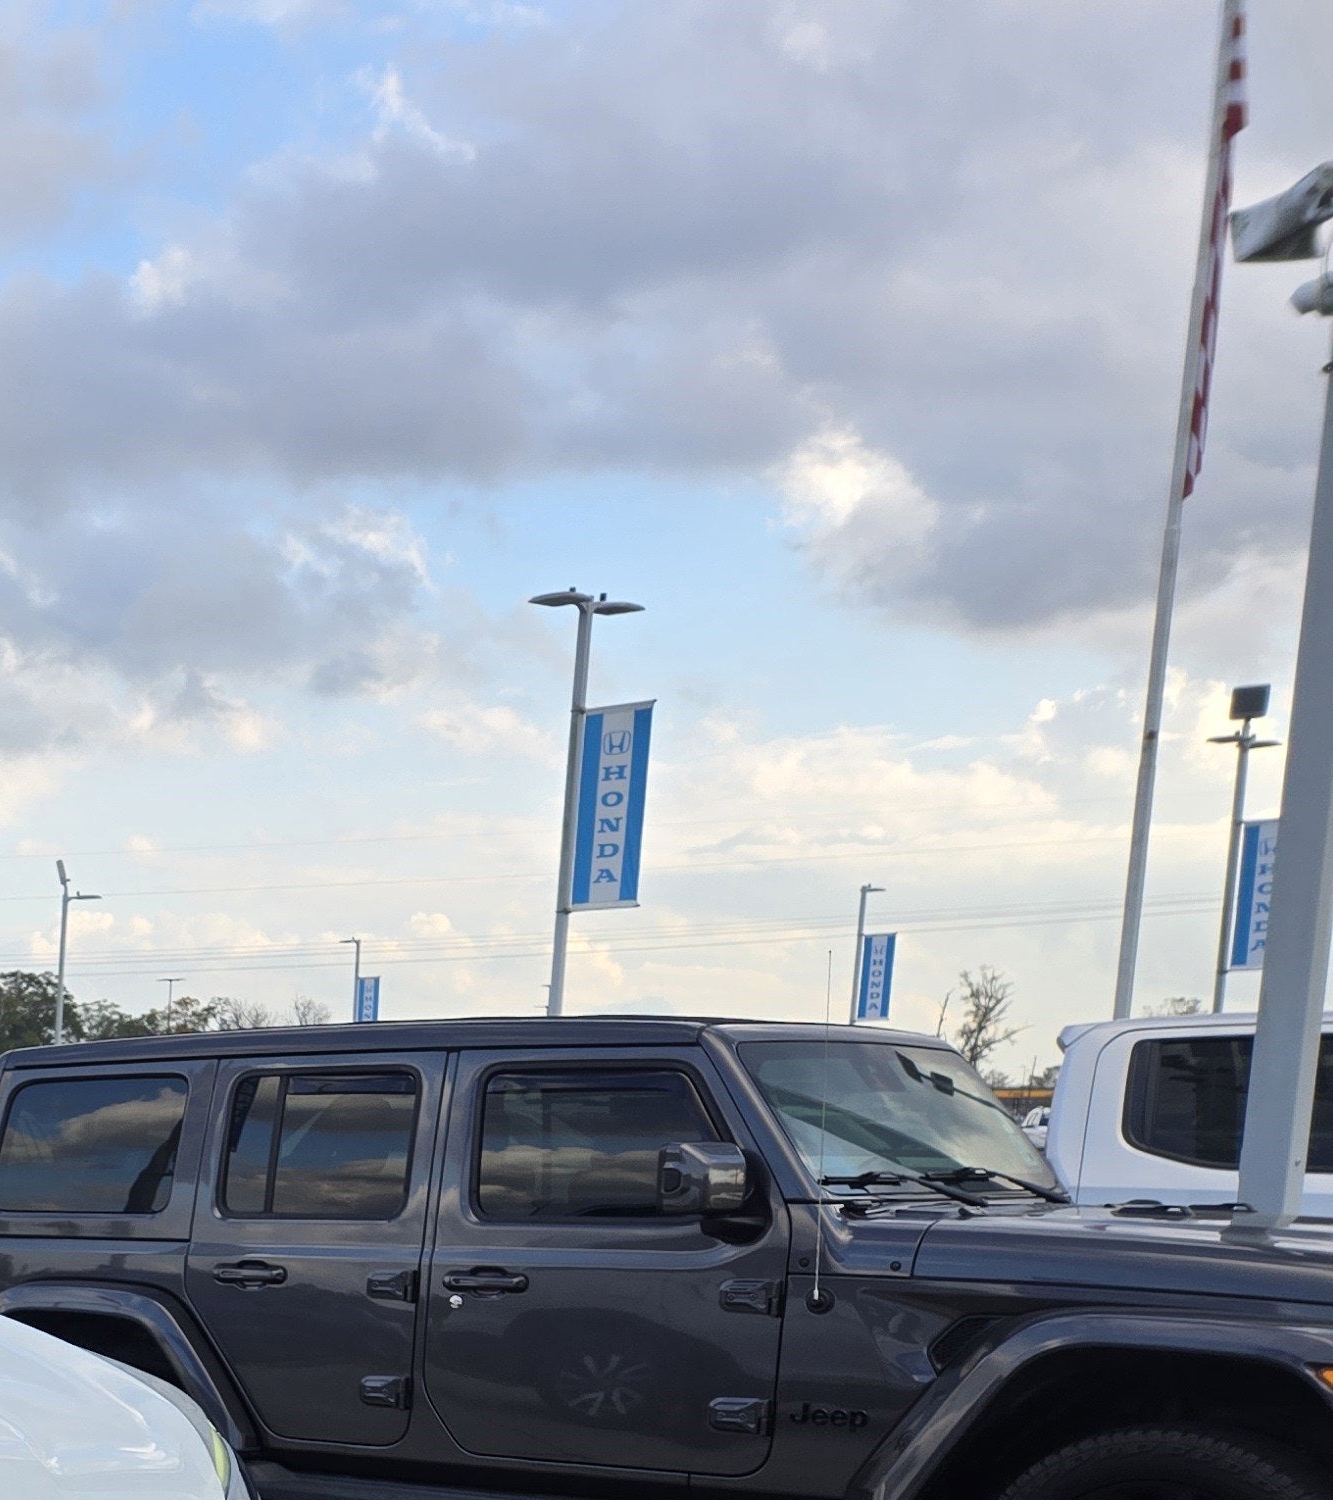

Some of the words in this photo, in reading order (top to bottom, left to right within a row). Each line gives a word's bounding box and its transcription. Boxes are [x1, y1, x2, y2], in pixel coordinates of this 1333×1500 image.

[592, 764, 628, 884] HONDA
[867, 957, 883, 1011] HONDA
[789, 1402, 869, 1431] Jeep
